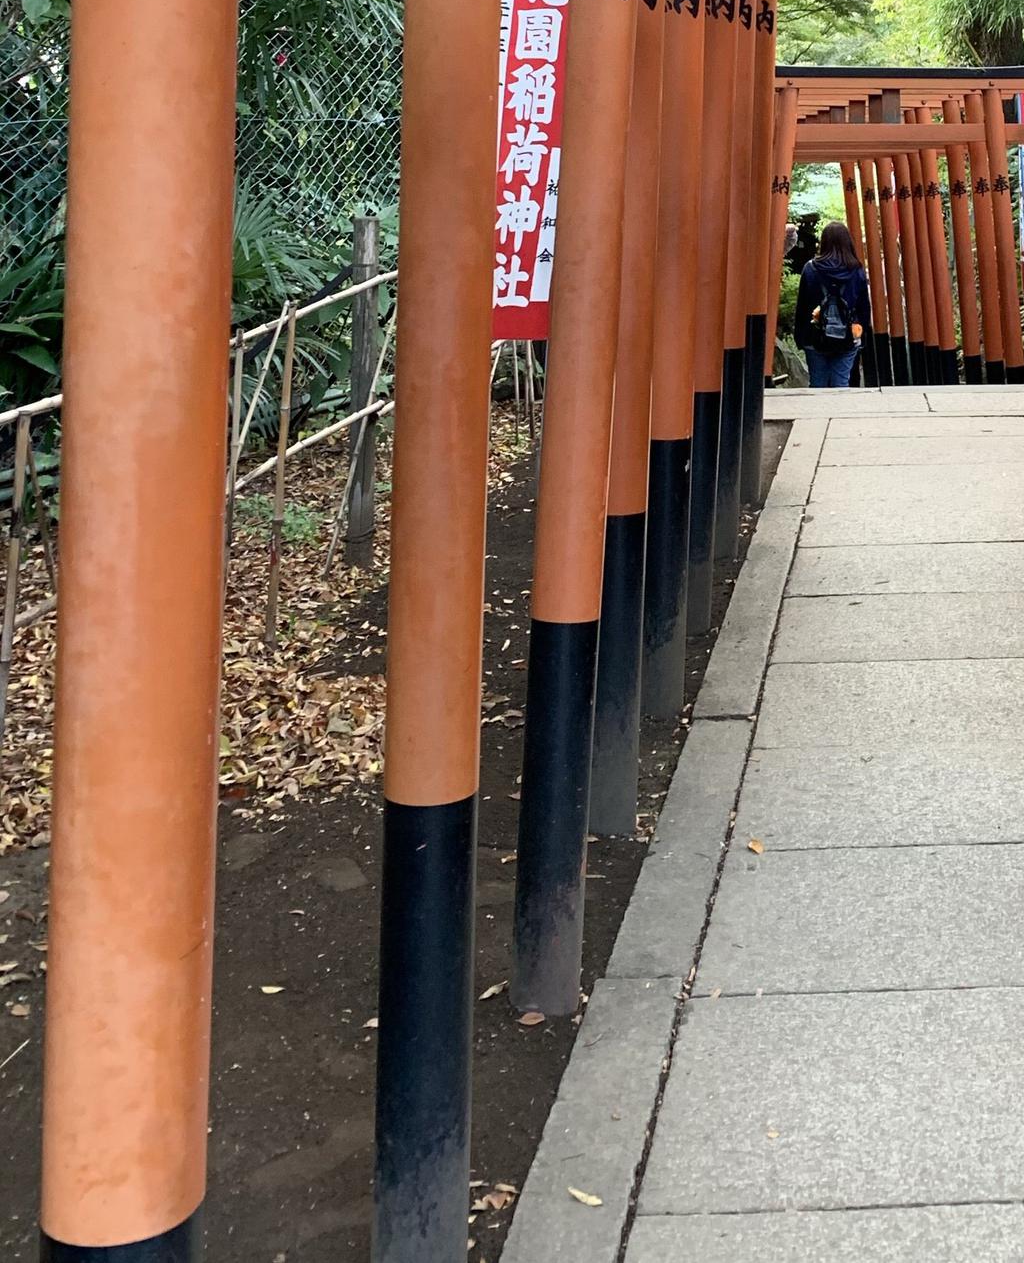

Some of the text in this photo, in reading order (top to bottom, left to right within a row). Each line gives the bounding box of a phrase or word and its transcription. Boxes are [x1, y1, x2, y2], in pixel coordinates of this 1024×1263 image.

[952, 180, 967, 199] 奉
[975, 177, 990, 197] 奉
[994, 174, 1011, 196] 奉
